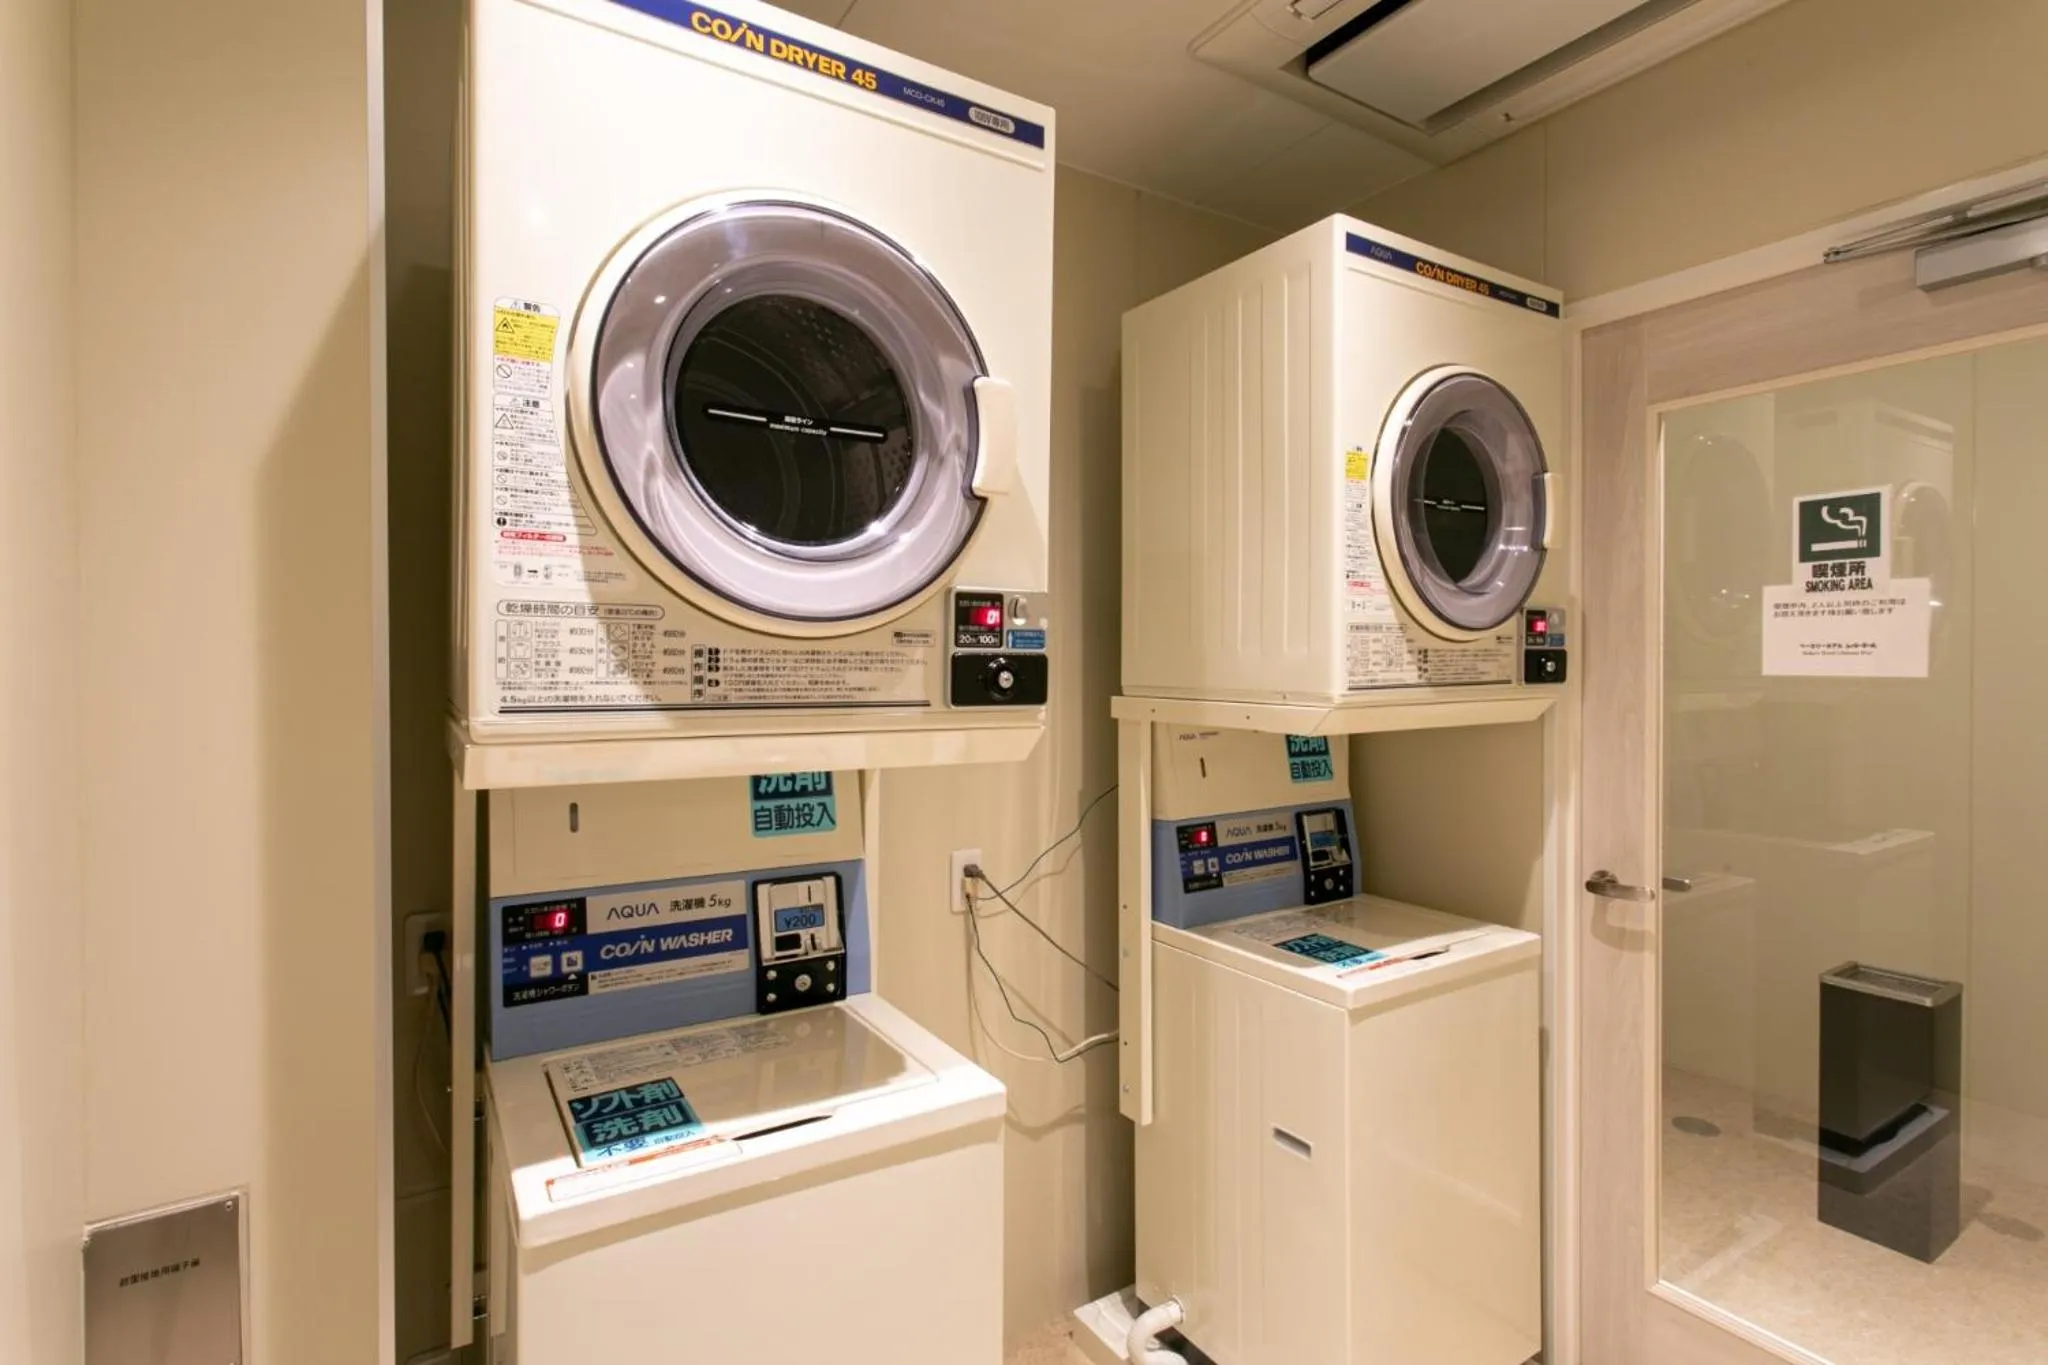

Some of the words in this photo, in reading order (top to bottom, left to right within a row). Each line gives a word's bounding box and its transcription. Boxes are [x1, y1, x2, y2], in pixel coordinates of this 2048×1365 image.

[769, 39, 847, 81] DRYER
[850, 68, 879, 91] 45
[1446, 273, 1477, 293] DRYER
[1811, 560, 1866, 579] 喫煙所
[1805, 578, 1846, 593] SMOKING
[1847, 577, 1873, 591] AREA
[754, 802, 836, 831] 自動投入
[1226, 825, 1253, 838] AQUA
[1254, 845, 1290, 860] WASHER
[606, 901, 660, 921] AQUA
[669, 897, 706, 913] 洗濯機
[707, 894, 732, 909] 5kg
[554, 912, 566, 928] 0
[783, 913, 817, 929] ¥200
[659, 927, 733, 951] WASHER
[571, 1078, 682, 1119] ソフト剤
[591, 1102, 684, 1143] 洗剤
[597, 1135, 649, 1157] 不要
